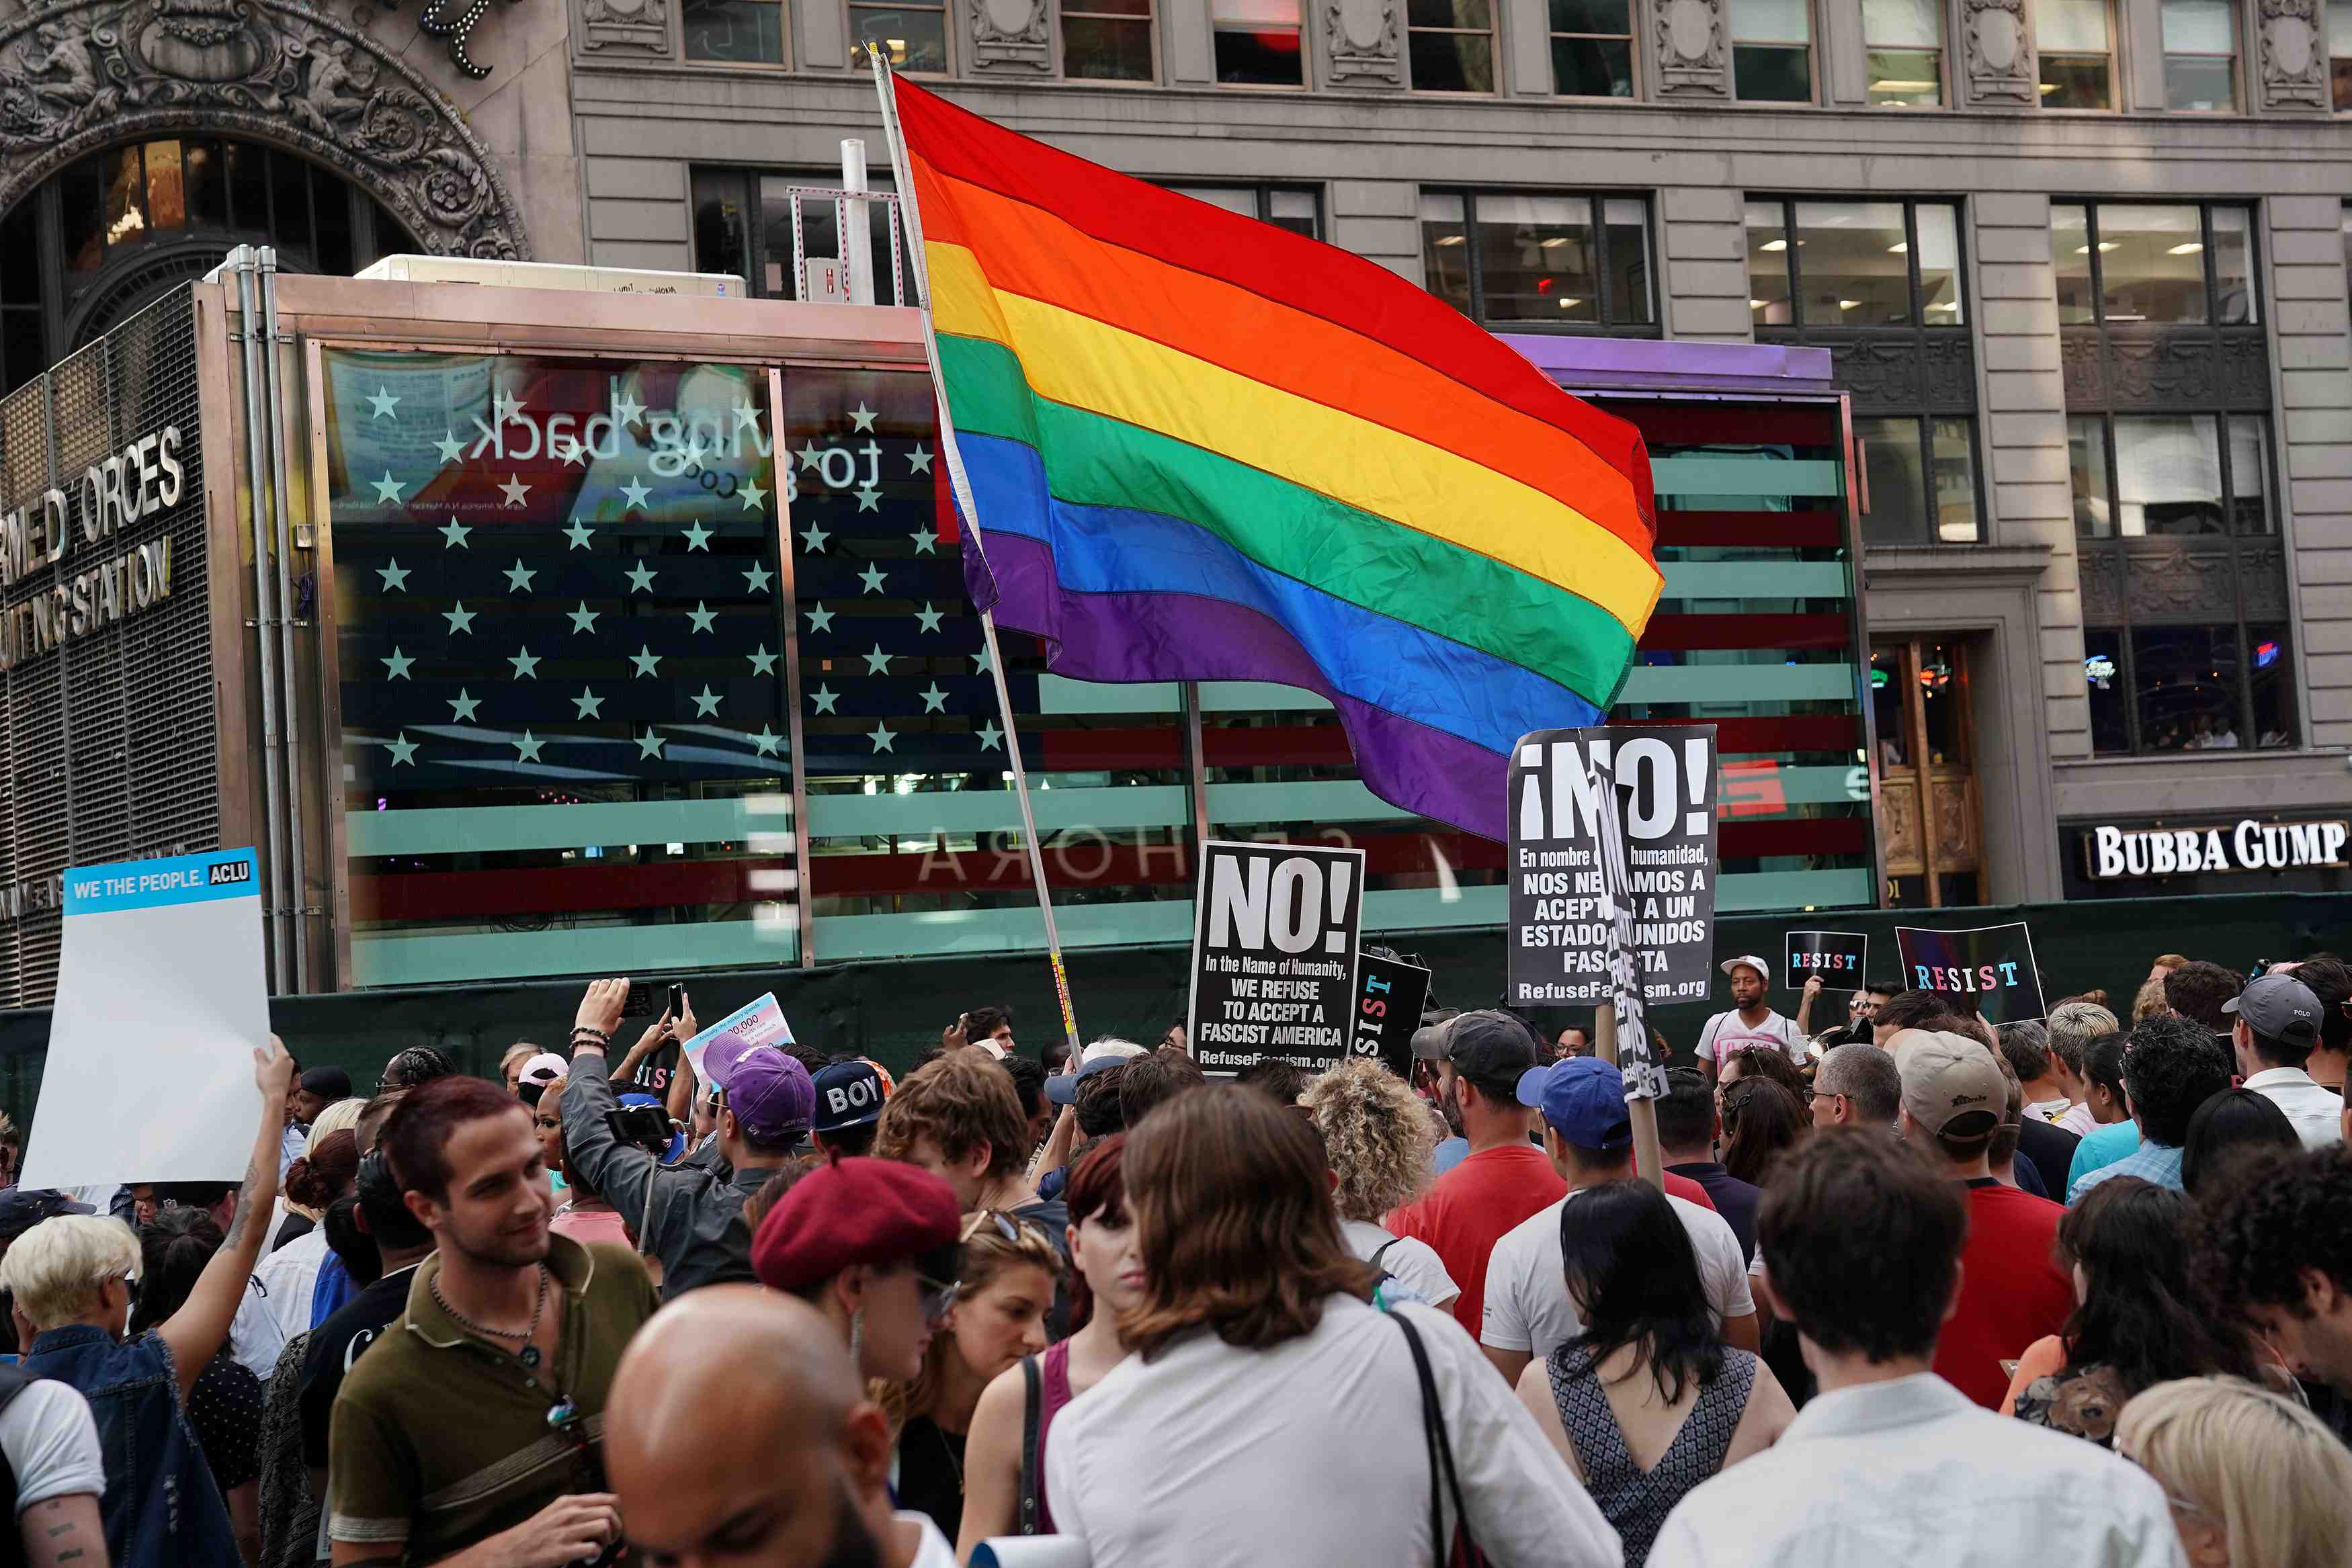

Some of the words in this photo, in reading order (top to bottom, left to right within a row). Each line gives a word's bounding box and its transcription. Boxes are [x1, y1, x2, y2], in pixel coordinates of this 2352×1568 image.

[1519, 848, 1536, 868] En
[1540, 846, 1590, 867] nombre
[1630, 844, 1709, 866] humanidad,
[2095, 826, 2230, 877] BUBBA
[2234, 820, 2347, 869] GUMP
[74, 881, 101, 899] WE
[103, 877, 136, 896] THE
[139, 869, 204, 892] PEOPLE.
[210, 863, 249, 883] ACLU
[1523, 873, 1568, 895] NOS
[1575, 870, 1685, 893] NEMOS
[1690, 869, 1706, 891] A
[1208, 854, 1352, 953] NO!
[1534, 897, 1636, 920] ACEPTR
[1643, 898, 1660, 919] A
[1666, 896, 1695, 918] UN
[1521, 923, 1608, 947] ESTADO
[1205, 955, 1217, 971] In
[1220, 955, 1239, 973] the
[1243, 956, 1276, 974] Name
[1279, 959, 1290, 975] of
[1292, 959, 1346, 980] Humanity,
[1792, 953, 1856, 969] RESIST
[1915, 961, 2018, 992] RESIST
[1231, 978, 1258, 998] WE
[1261, 979, 1320, 1000] REFUSE
[1519, 980, 1706, 1000] RefuseFasm.org
[1223, 1001, 1245, 1020] TO
[1247, 1002, 1310, 1022] ACCEPT
[1312, 1005, 1325, 1022] A
[2294, 1009, 2311, 1017] POLO
[1201, 1022, 1269, 1044] FASCIST
[1271, 1026, 1342, 1046] AMERICA
[827, 1076, 878, 1114] BOY
